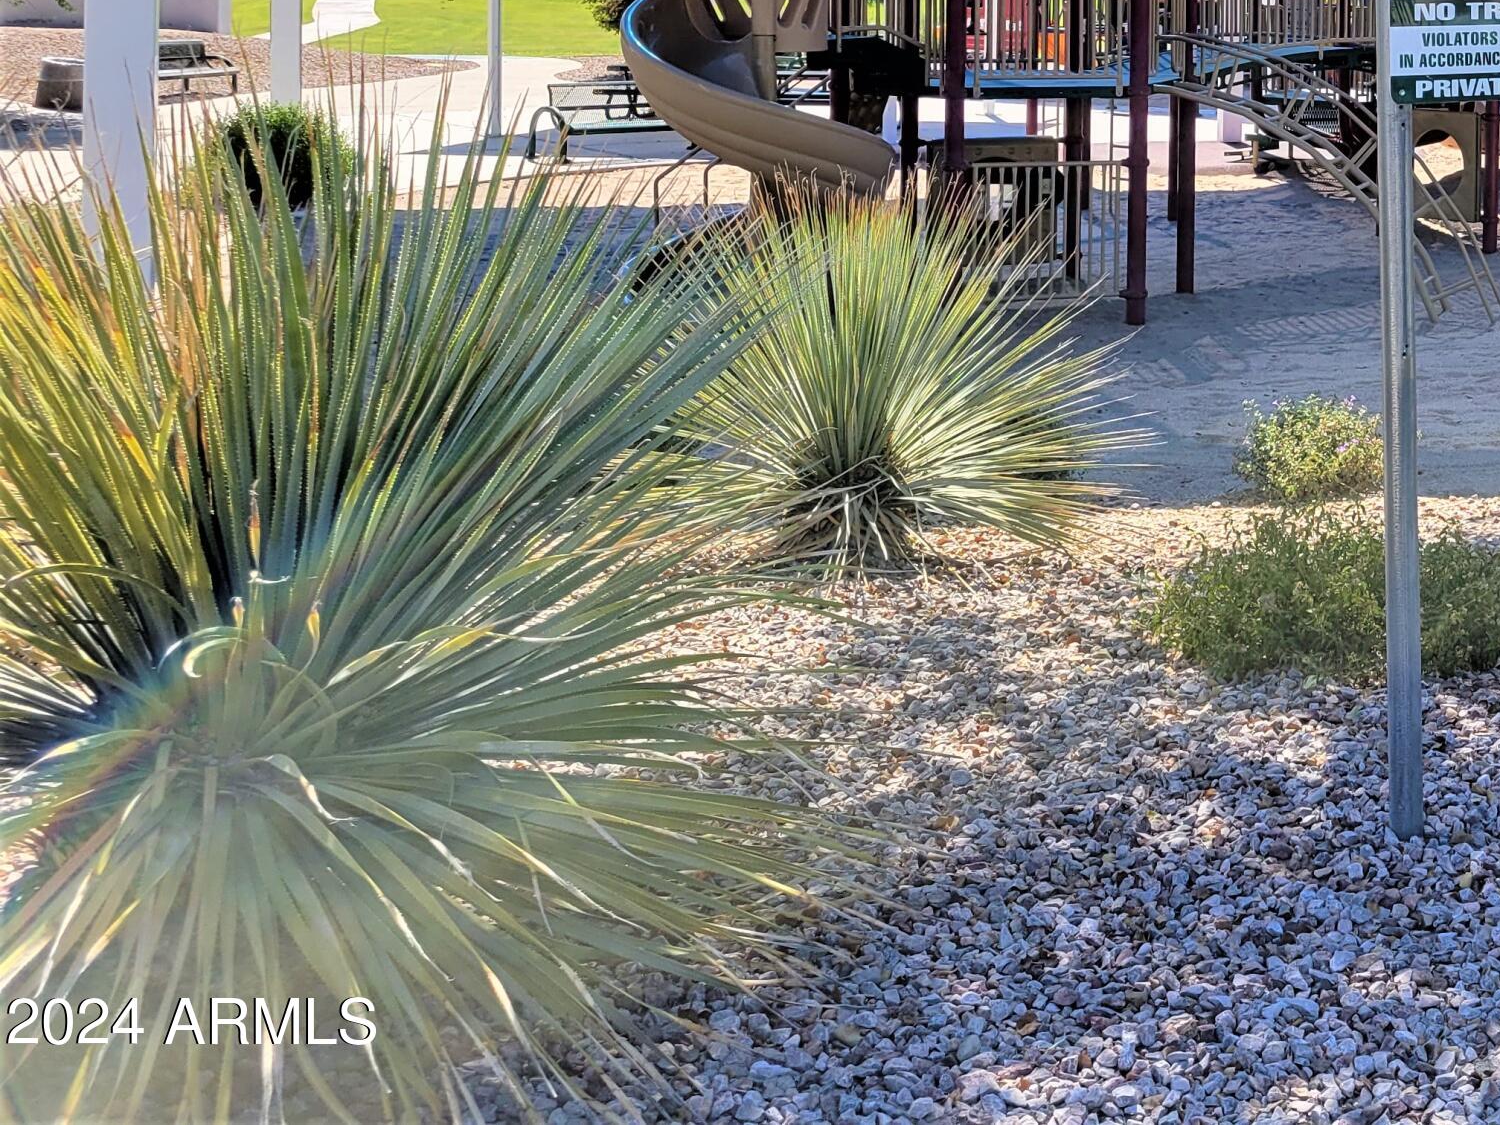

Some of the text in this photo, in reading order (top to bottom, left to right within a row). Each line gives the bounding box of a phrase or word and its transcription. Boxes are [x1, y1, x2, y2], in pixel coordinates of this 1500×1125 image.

[1414, 2, 1456, 21] NO
[1422, 32, 1498, 47] VIOLATORS
[1400, 54, 1414, 68] IN
